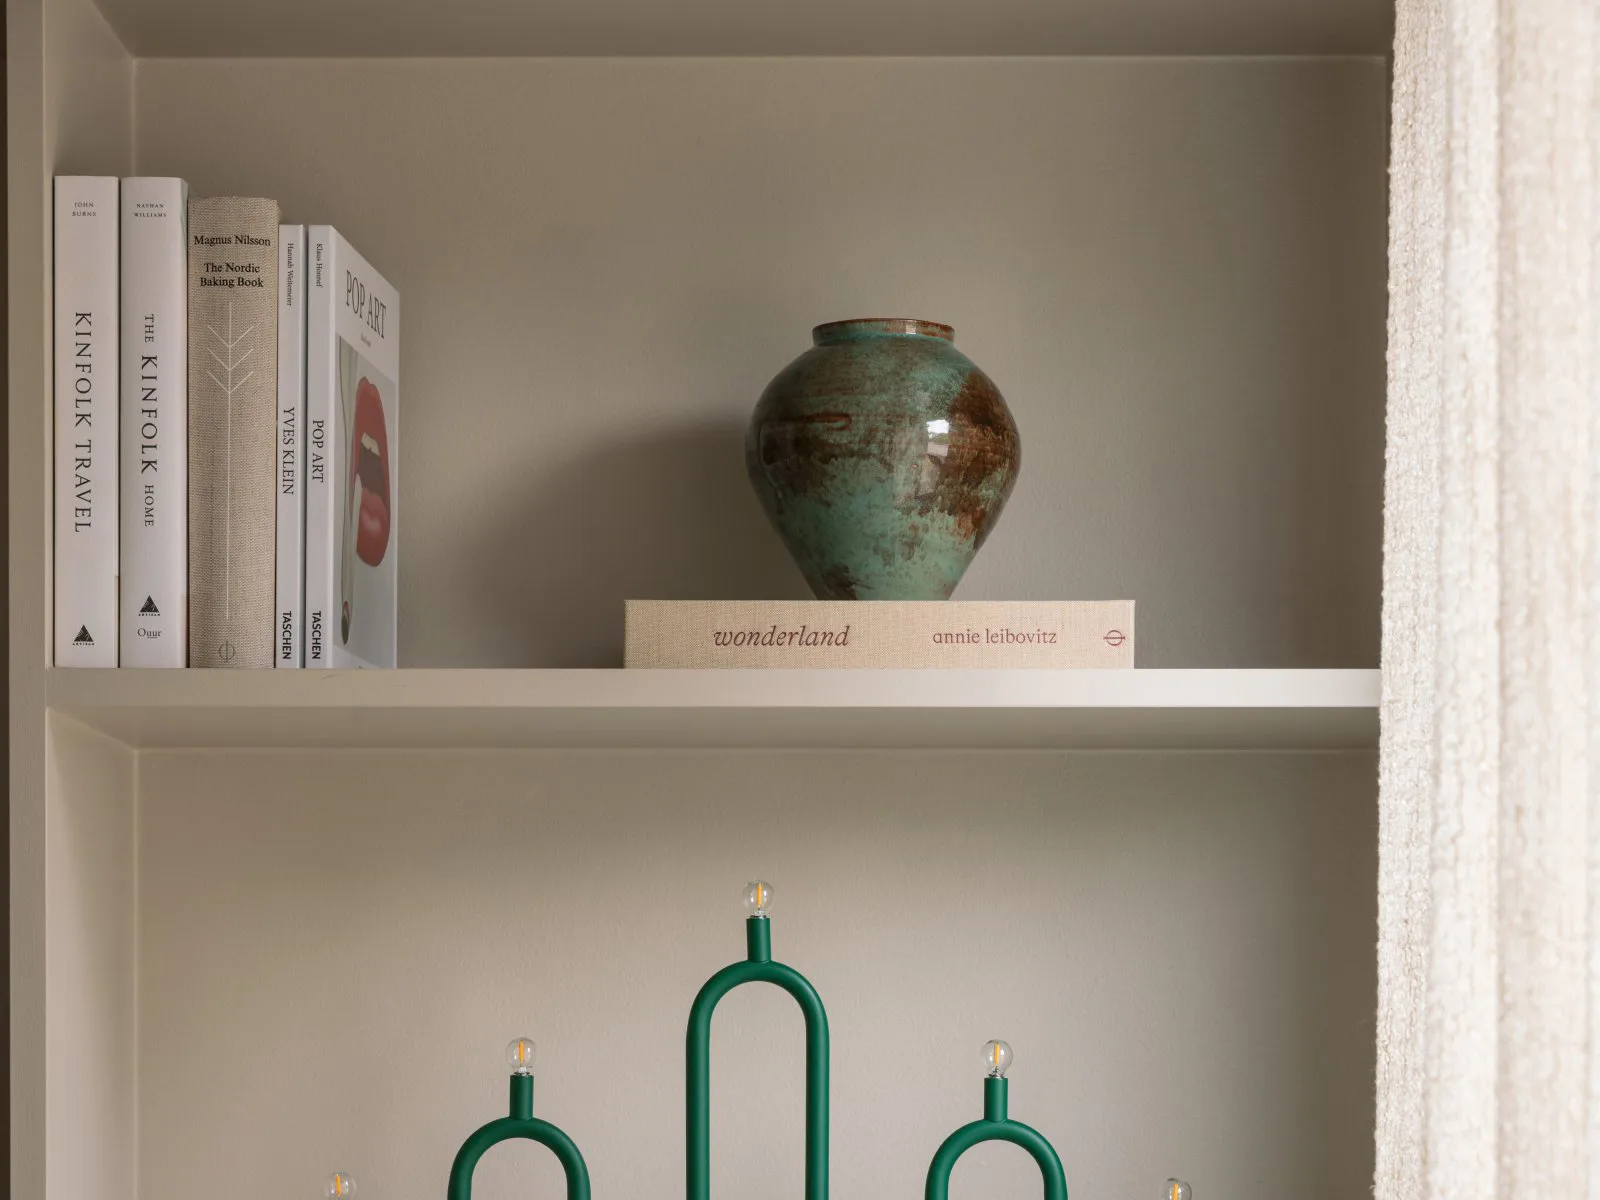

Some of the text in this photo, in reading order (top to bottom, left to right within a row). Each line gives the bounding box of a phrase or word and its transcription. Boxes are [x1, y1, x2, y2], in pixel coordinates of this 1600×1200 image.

[194, 234, 271, 246] Magnus Nilsson
[200, 276, 264, 288] Baking Book
[204, 262, 260, 273] The Nordic
[286, 243, 295, 307] Hannah Weitemeier
[346, 269, 366, 319] POP
[366, 292, 387, 339] ART
[75, 312, 92, 533] KINFOLK TRAVEL
[141, 313, 158, 527] THE KINFOLK HOME
[282, 406, 295, 495] YVES KLEIN
[312, 420, 324, 483] POP ART
[137, 627, 162, 637] Ouur
[282, 610, 292, 660] TASCHEN
[311, 610, 322, 660] TASCHEN
[713, 625, 850, 647] wonderland
[932, 628, 1057, 645] annie leibovitz
